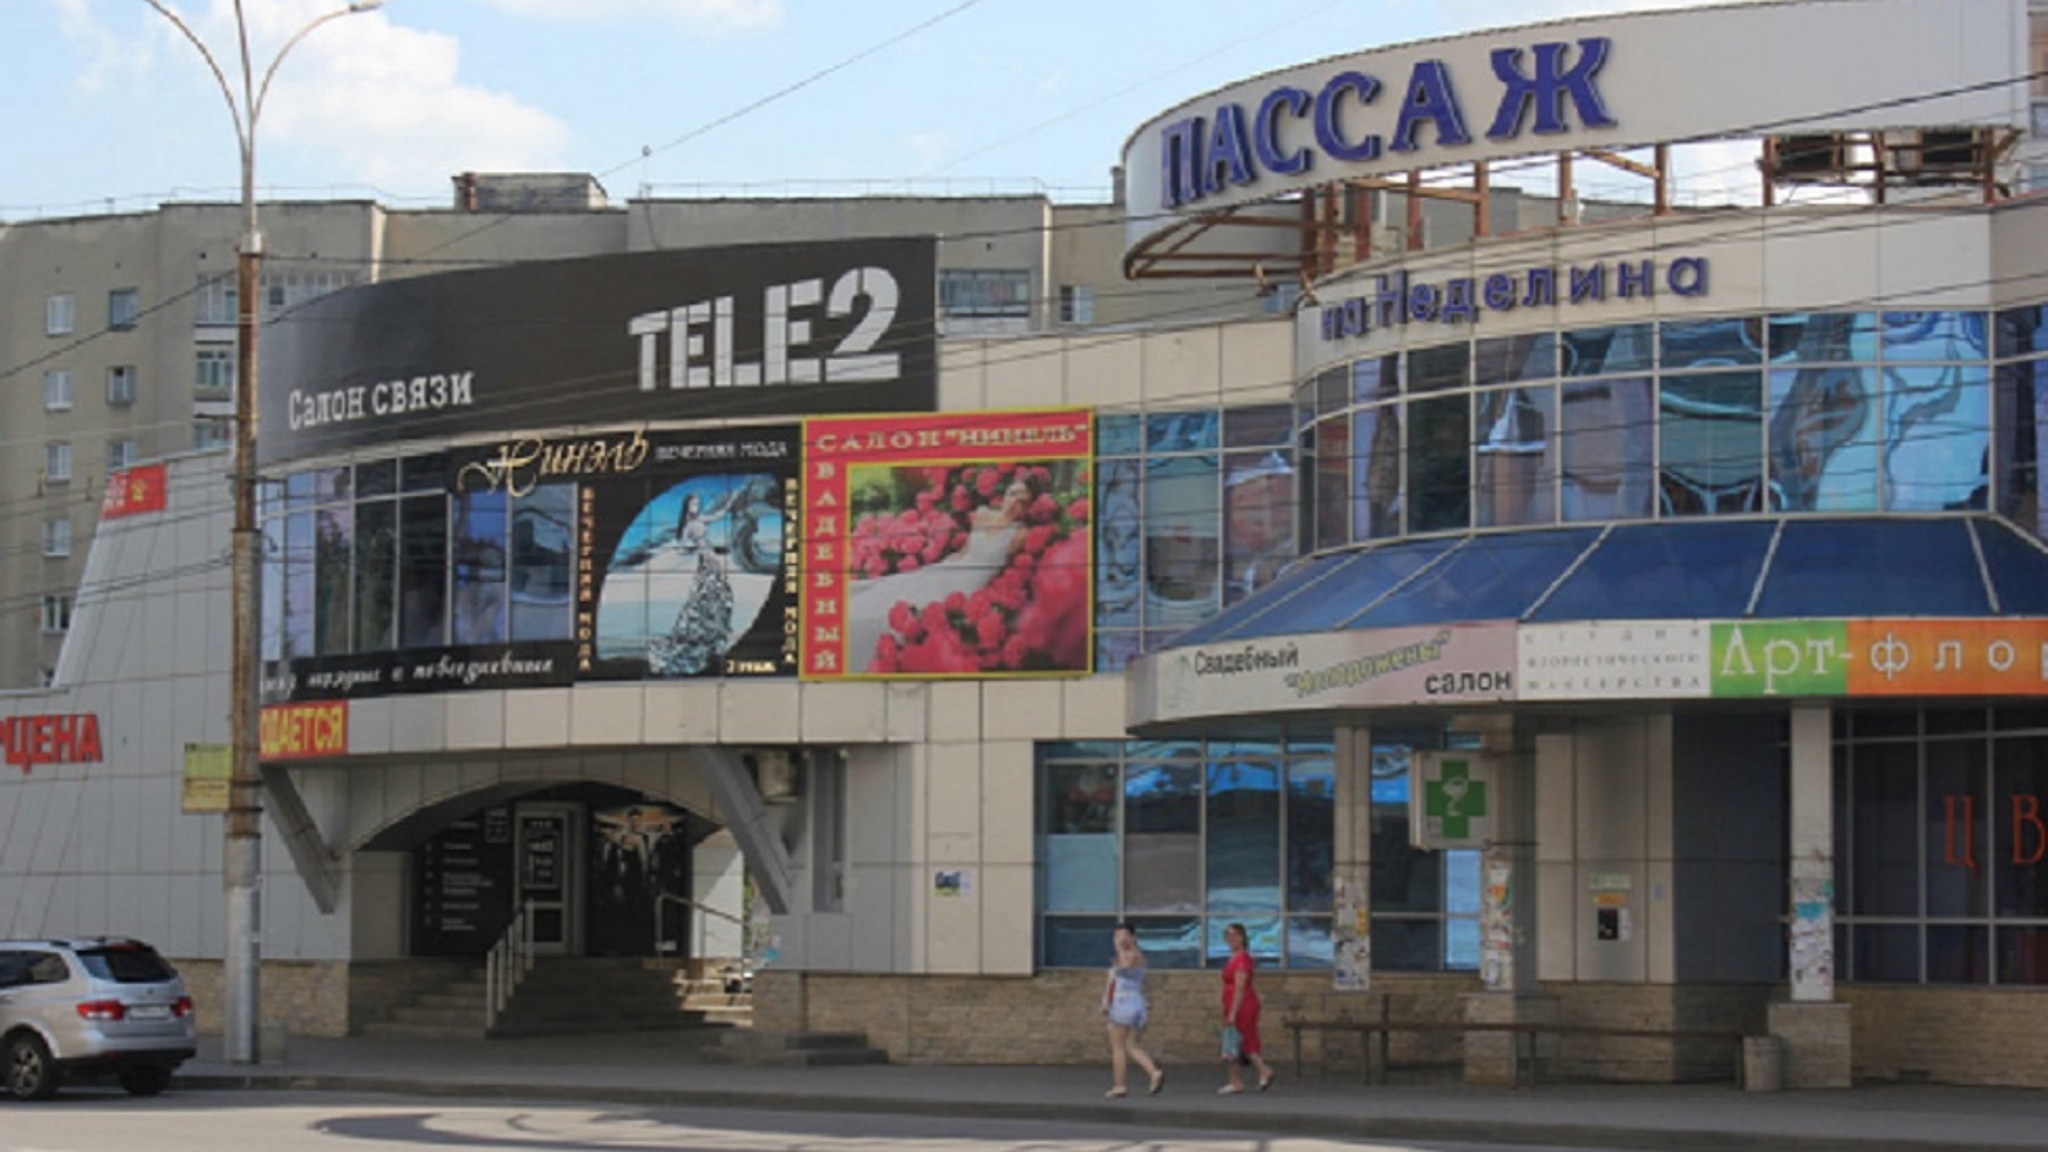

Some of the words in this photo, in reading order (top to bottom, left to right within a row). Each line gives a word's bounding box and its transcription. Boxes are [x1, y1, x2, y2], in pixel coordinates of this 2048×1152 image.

[1160, 37, 1618, 209] ПАССАЖ
[1374, 256, 1712, 328] Неделина
[628, 266, 900, 391] TELE2
[288, 386, 366, 431] Салон
[813, 430, 942, 452] САЛОН
[1194, 641, 1300, 676] Свадебный
[1424, 670, 1514, 695] салон
